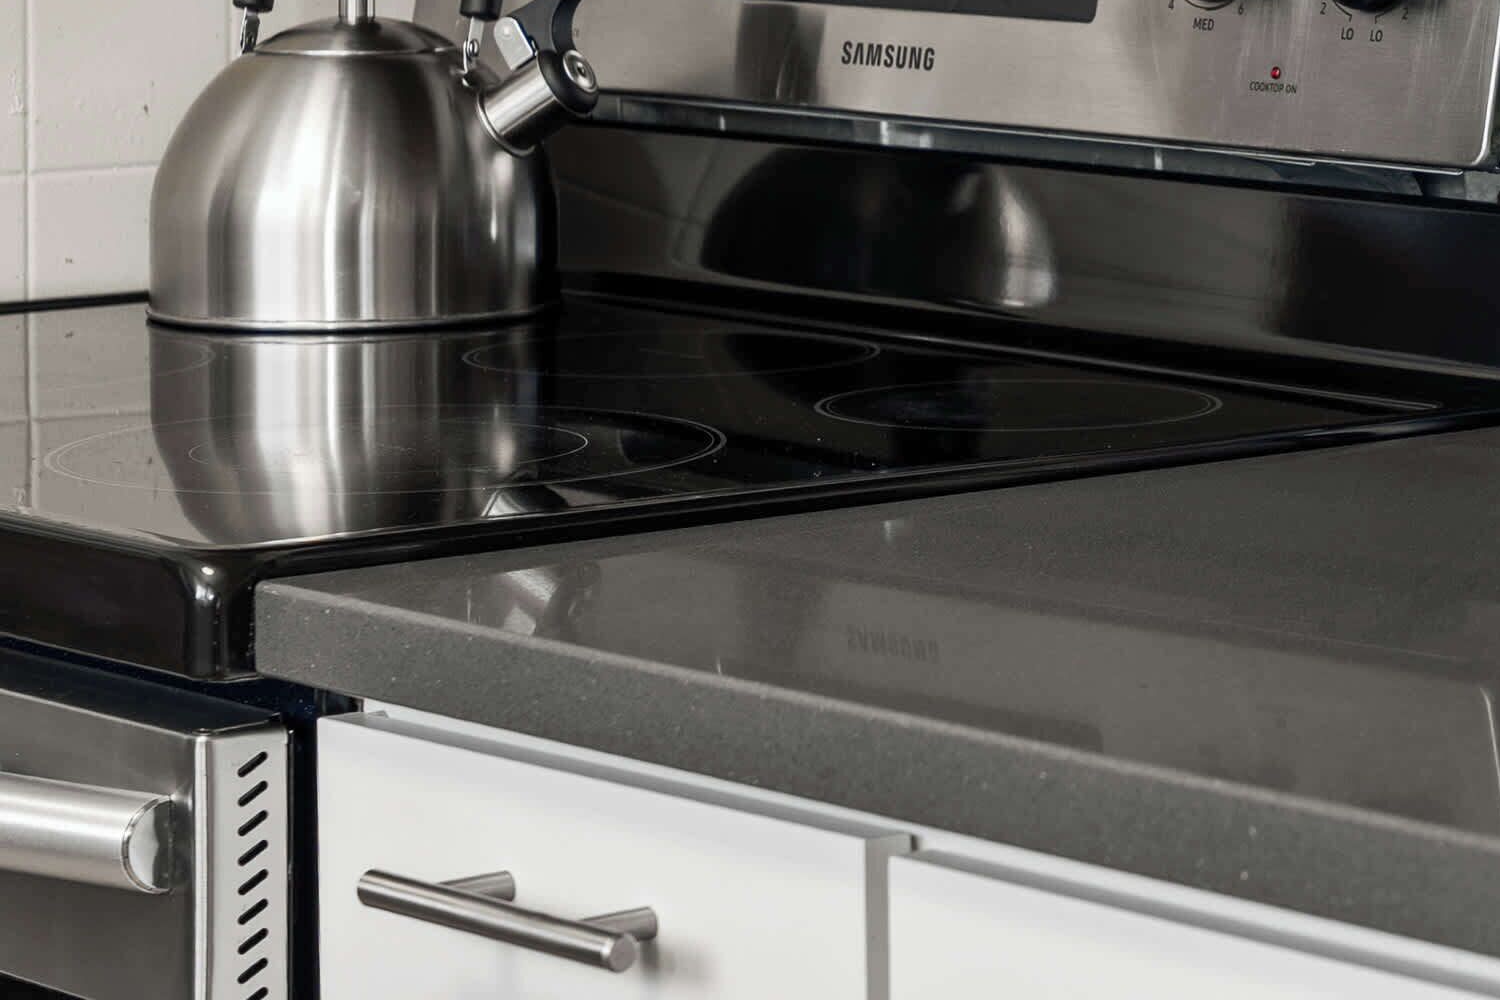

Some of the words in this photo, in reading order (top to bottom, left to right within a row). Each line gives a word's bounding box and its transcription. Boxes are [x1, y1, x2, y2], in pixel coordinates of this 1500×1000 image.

[1237, 3, 1244, 15] 6
[1319, 2, 1326, 15] 2
[1402, 7, 1409, 20] 2
[1192, 18, 1214, 31] MED
[1341, 28, 1354, 41] LO
[1369, 29, 1383, 42] LO
[841, 40, 936, 71] SAMSUNG
[1250, 81, 1284, 93] COOKTOP
[1286, 84, 1297, 94] ON
